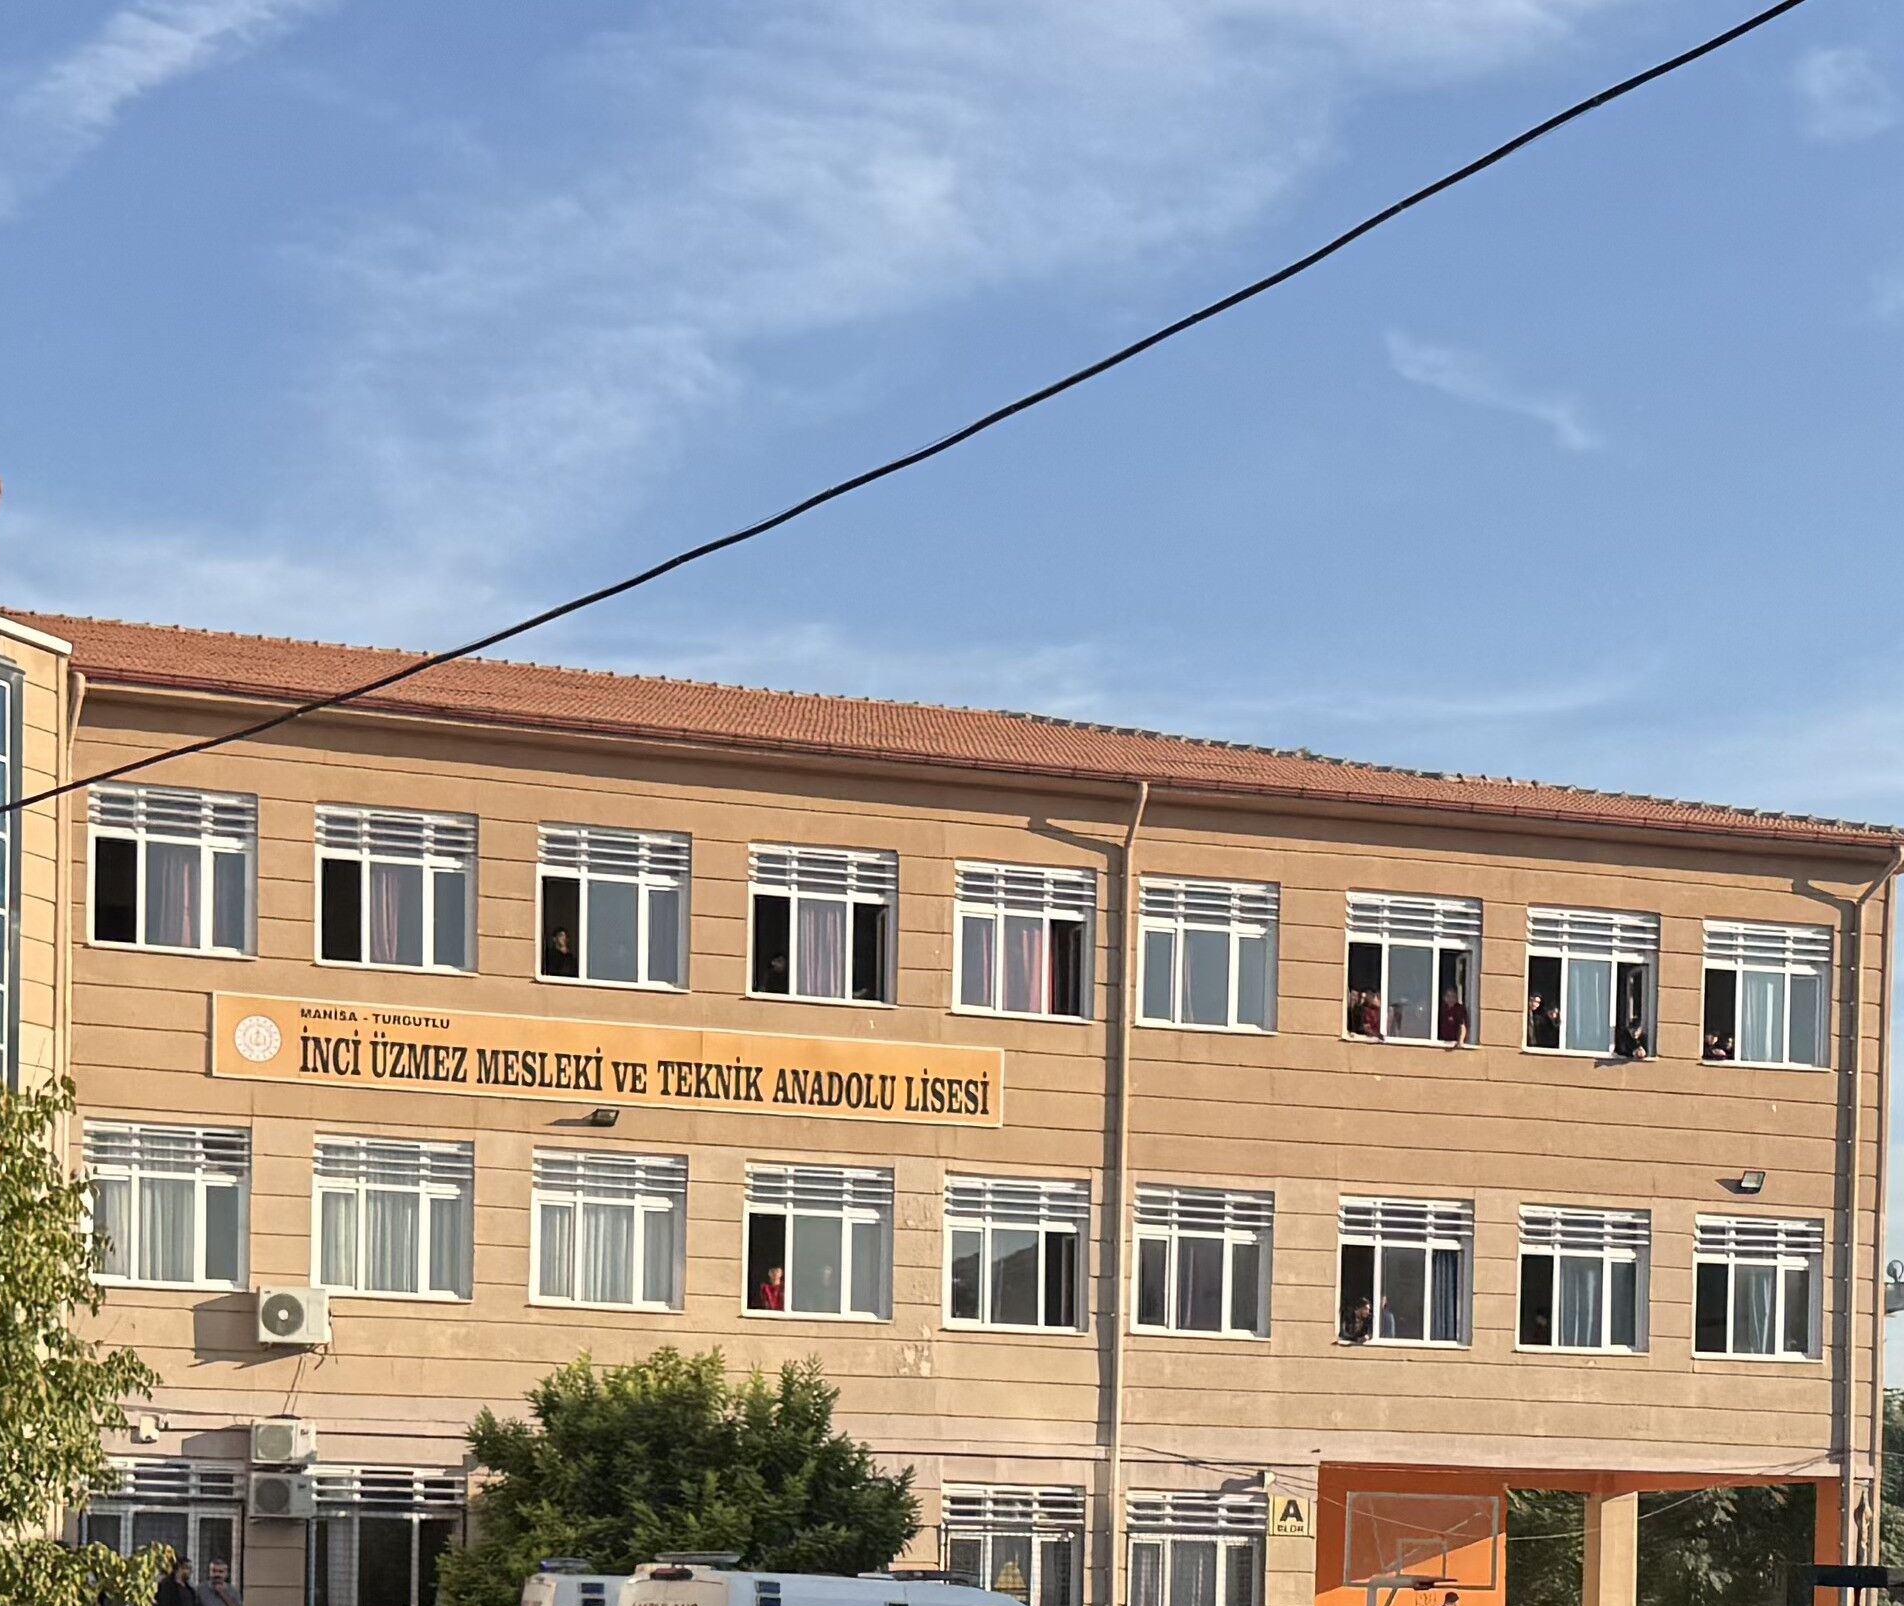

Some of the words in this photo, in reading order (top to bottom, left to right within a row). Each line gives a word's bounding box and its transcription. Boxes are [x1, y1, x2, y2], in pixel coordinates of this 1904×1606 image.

[300, 1007, 358, 1022] MANİSA
[372, 1013, 450, 1029] TURGUTLU
[299, 1025, 362, 1076] İNCİ
[369, 1030, 468, 1083] ÜZMEZ
[476, 1046, 603, 1091] MESLEKİ
[611, 1060, 647, 1094] VE
[657, 1056, 763, 1102] TEKNİK
[772, 1068, 896, 1110] ANADOLU
[904, 1067, 990, 1115] LİSESİ
[1279, 1499, 1304, 1522] A
